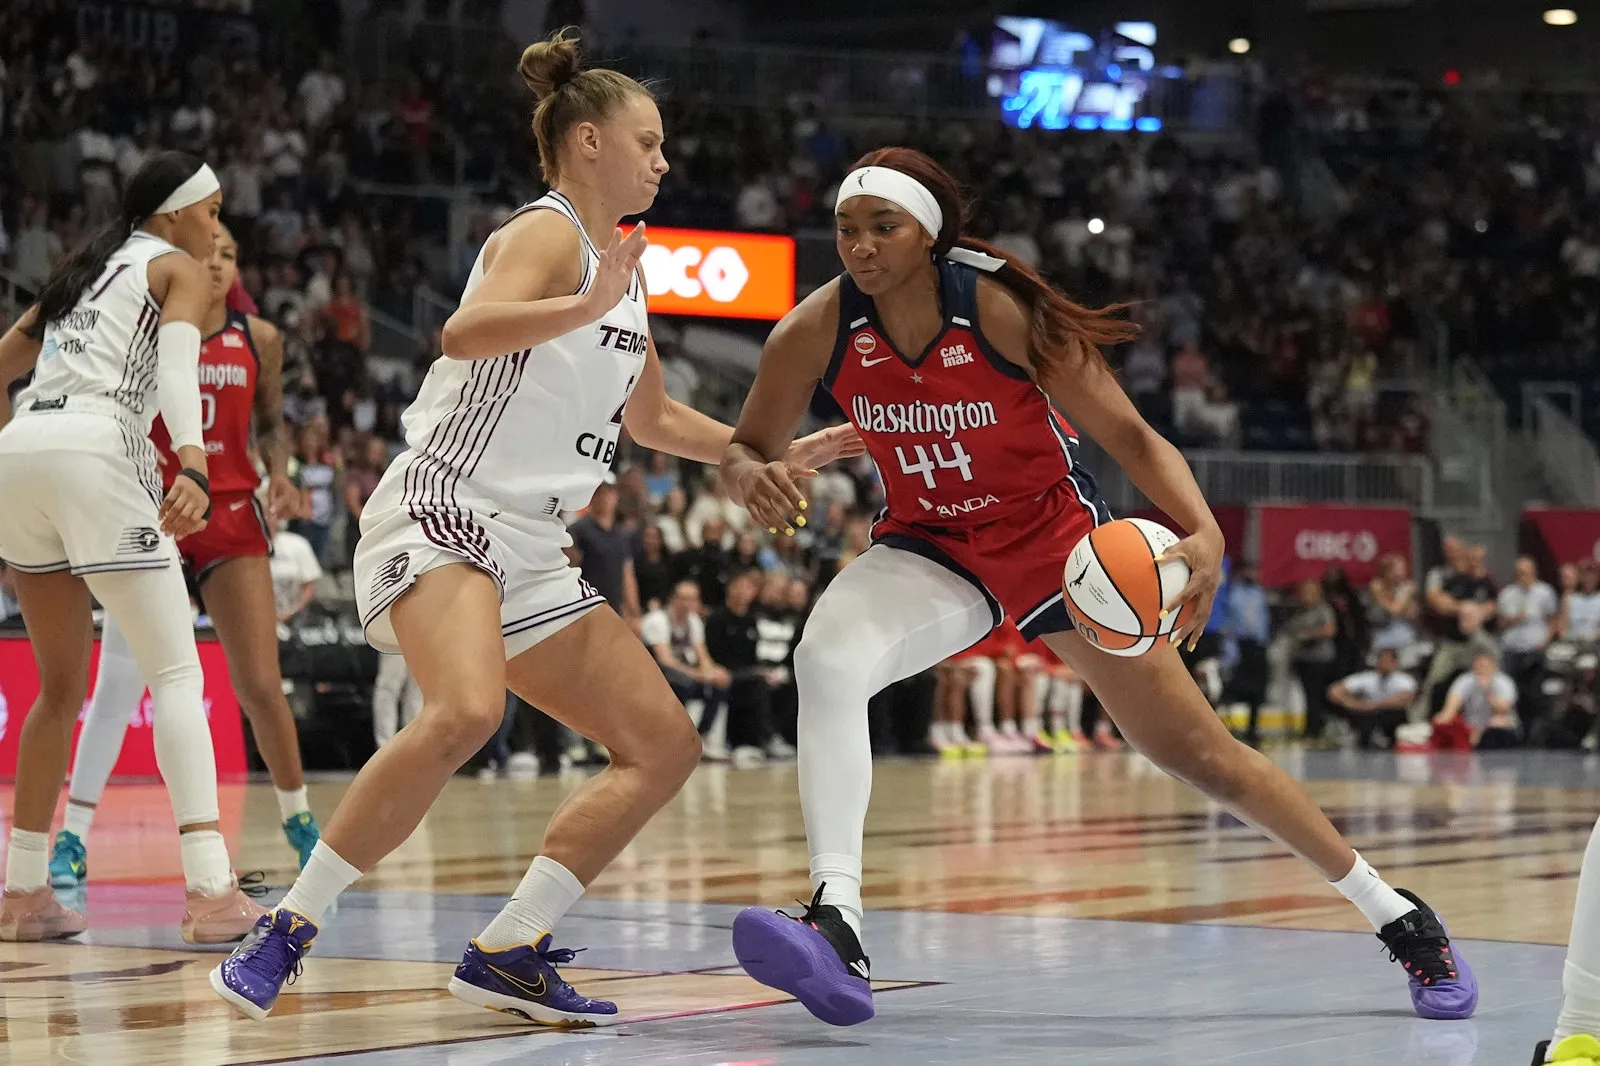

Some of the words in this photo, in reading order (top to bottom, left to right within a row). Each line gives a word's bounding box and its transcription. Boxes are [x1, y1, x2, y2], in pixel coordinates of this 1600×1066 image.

[940, 345, 965, 357] CAR
[943, 353, 974, 368] max
[852, 395, 998, 439] Washington
[576, 432, 615, 463] CIB
[895, 441, 974, 489] 44
[937, 494, 1000, 518] ANDA
